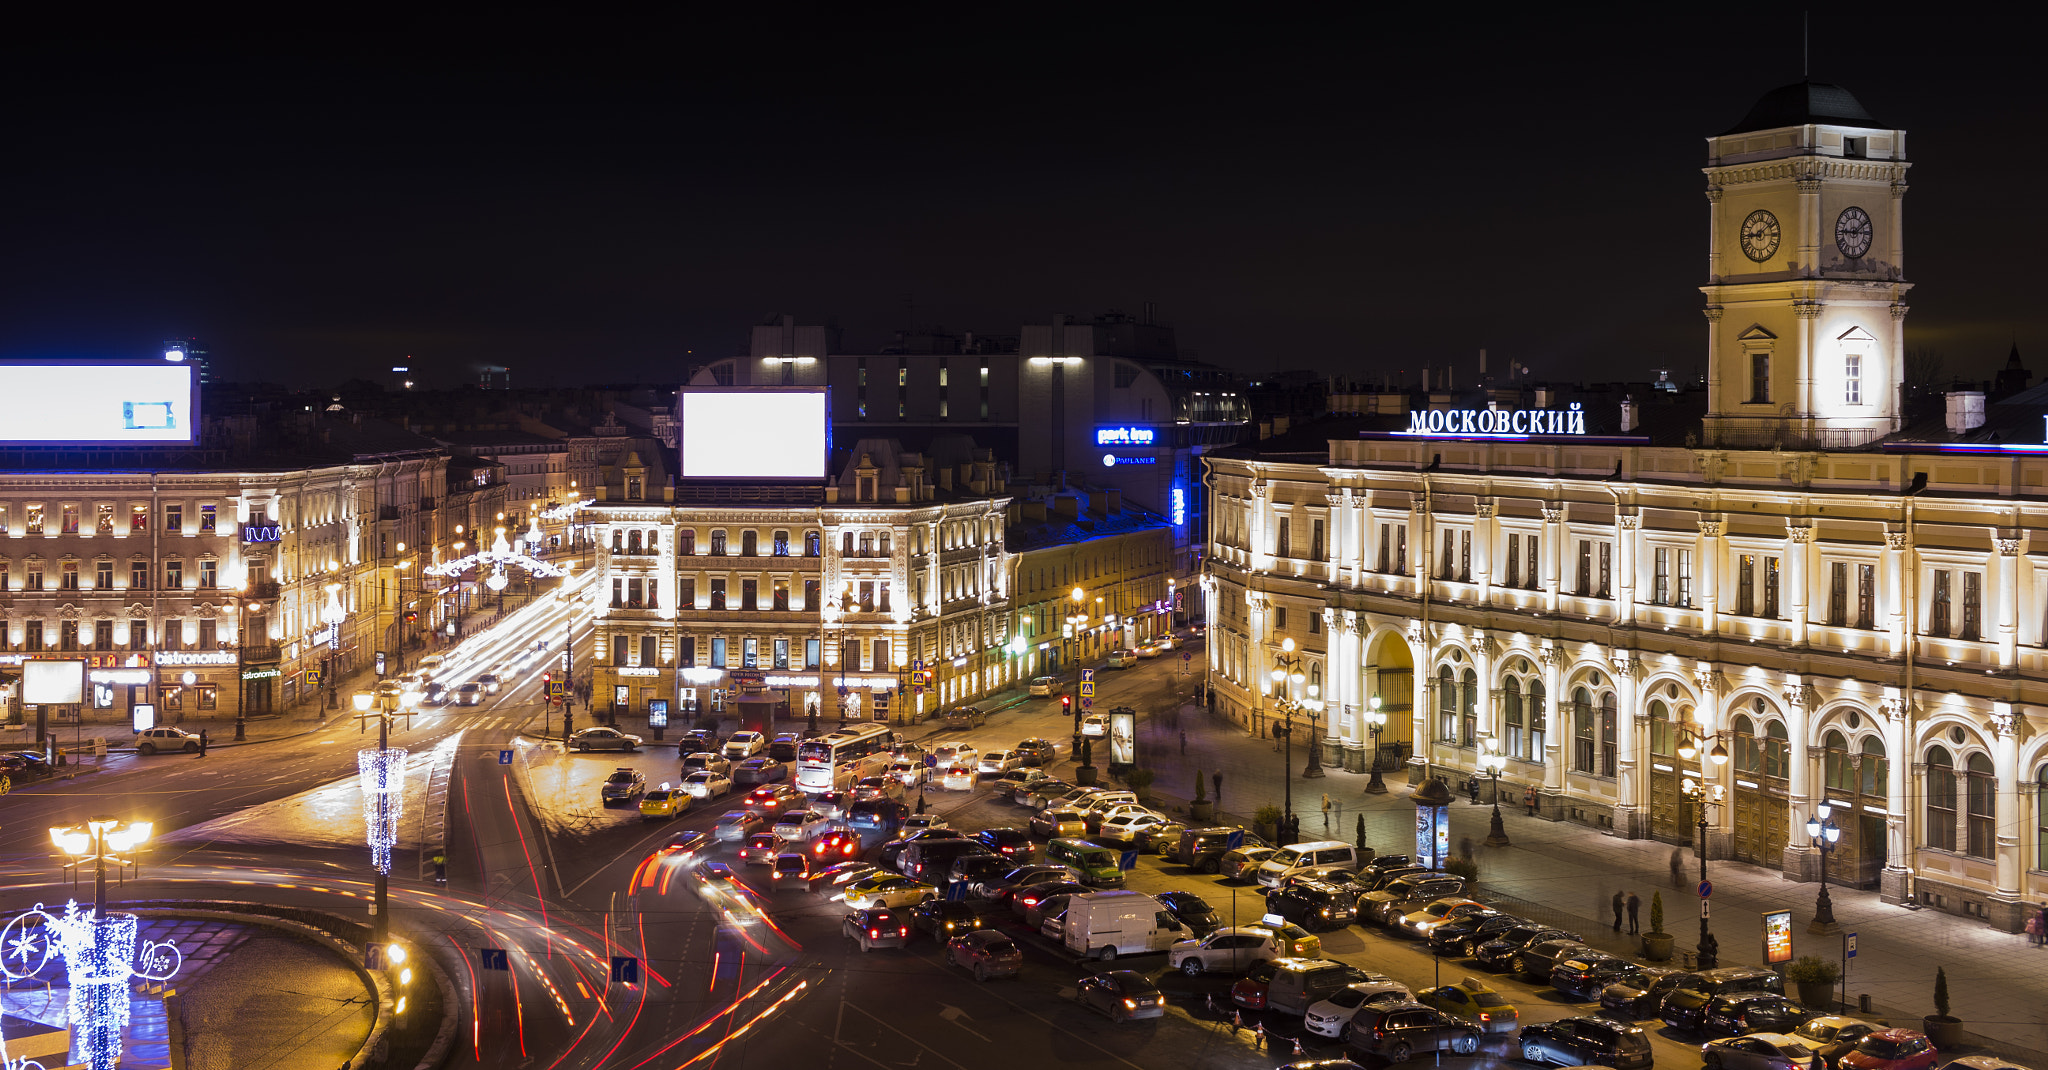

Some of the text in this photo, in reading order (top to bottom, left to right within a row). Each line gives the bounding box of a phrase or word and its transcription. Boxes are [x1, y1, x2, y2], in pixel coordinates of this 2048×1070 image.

[1410, 402, 1586, 434] МОСКОВСКИЙ
[1098, 427, 1153, 444] park inn
[1115, 457, 1156, 465] PAULANER
[154, 650, 237, 665] bistronomika
